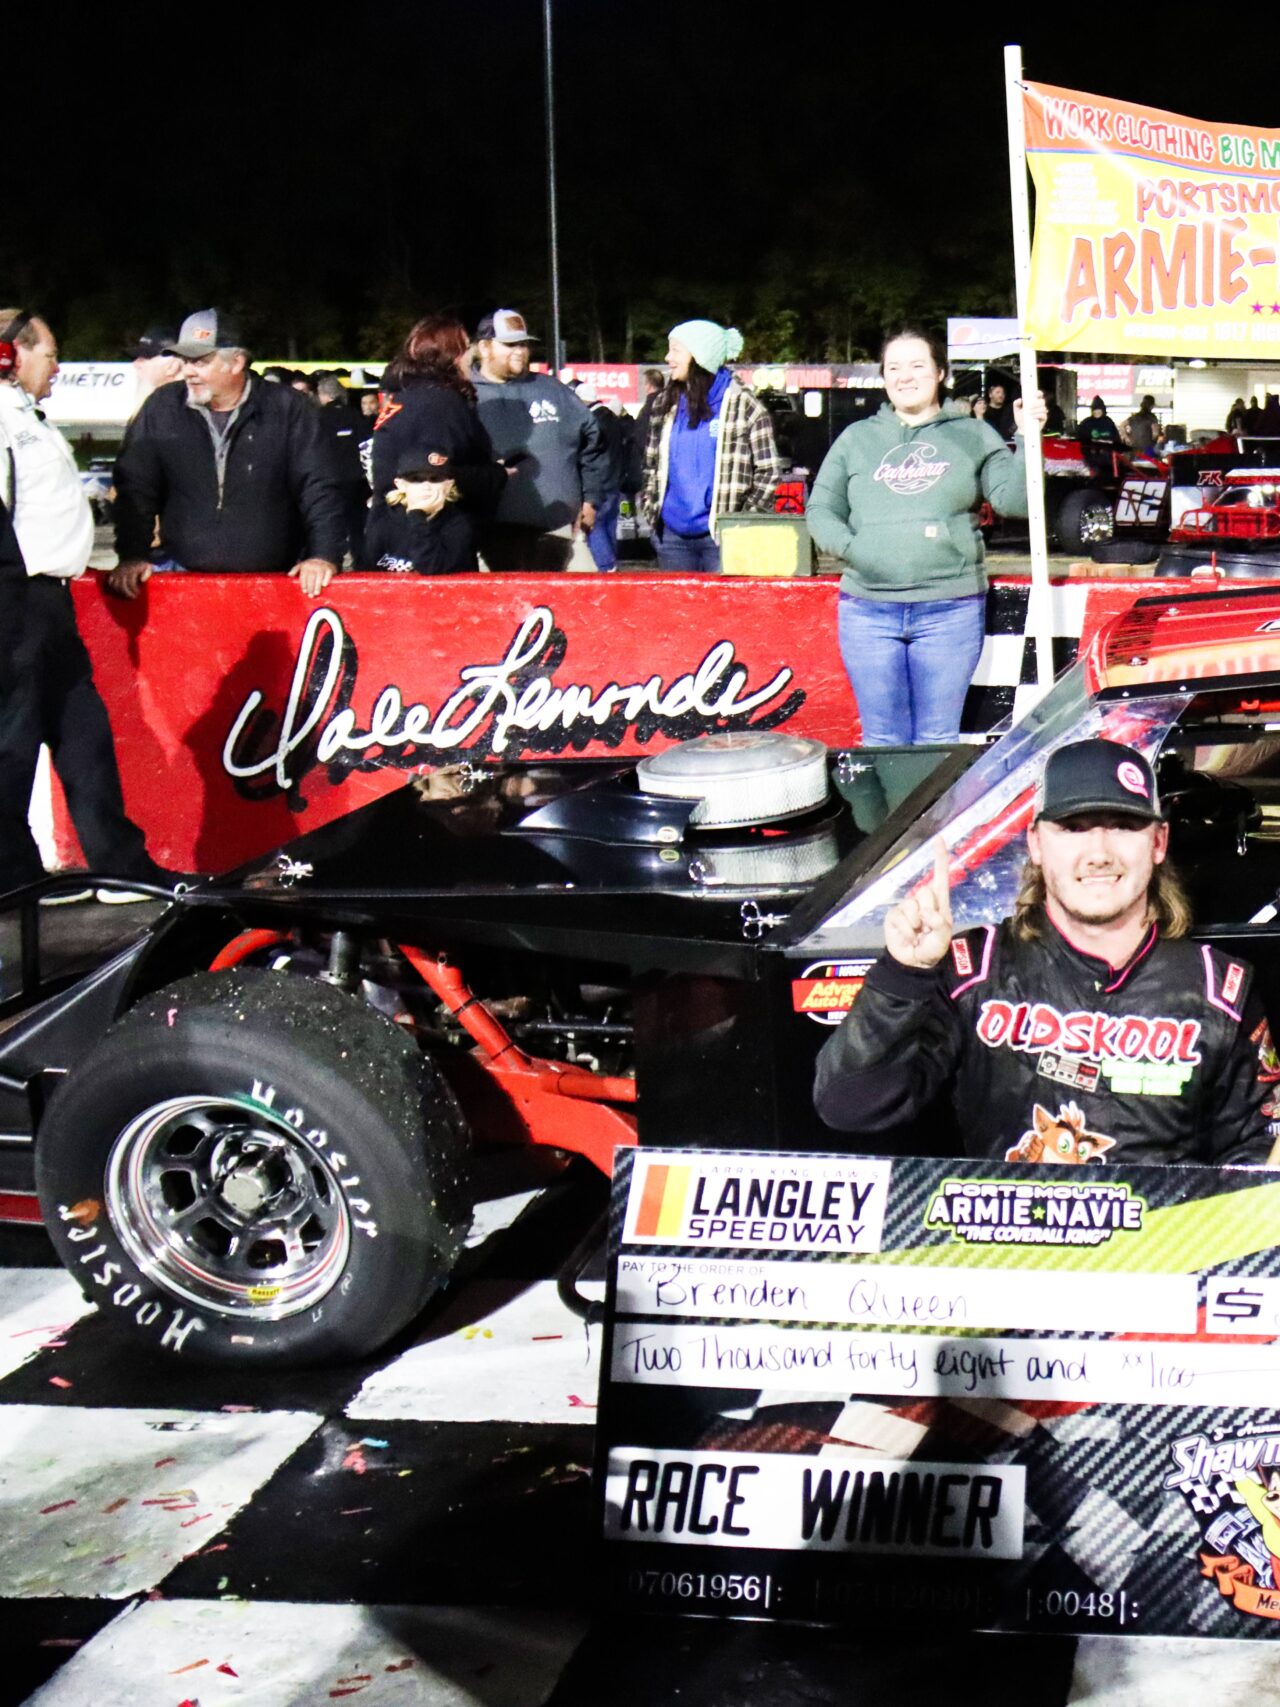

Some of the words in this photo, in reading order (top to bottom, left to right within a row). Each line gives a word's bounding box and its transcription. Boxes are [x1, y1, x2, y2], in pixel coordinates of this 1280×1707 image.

[1043, 97, 1111, 141] WORK
[1115, 114, 1215, 161] CLOTHING
[1219, 135, 1256, 168] BIG
[801, 995, 838, 1008] Auto
[976, 999, 1201, 1066] OLDSKOOL
[691, 1177, 876, 1222] LANGLEY
[929, 1197, 1031, 1225] ARMIE
[1046, 1200, 1142, 1229] NAVIE
[944, 1183, 1128, 1200] PORTSMOUTH
[687, 1219, 867, 1245] SPEEDWAY
[622, 1261, 646, 1272] PAY
[650, 1262, 667, 1272] TO
[699, 1264, 745, 1275] ORDER
[648, 1265, 808, 1310] Brenden
[848, 1278, 968, 1322] Queen
[621, 1335, 683, 1374] Two
[697, 1337, 833, 1370] Thousand
[849, 1340, 918, 1389] forty
[934, 1349, 1016, 1392] eight
[1026, 1350, 1091, 1383] and
[620, 1459, 760, 1537] RACE
[800, 1467, 1003, 1549] WINNER
